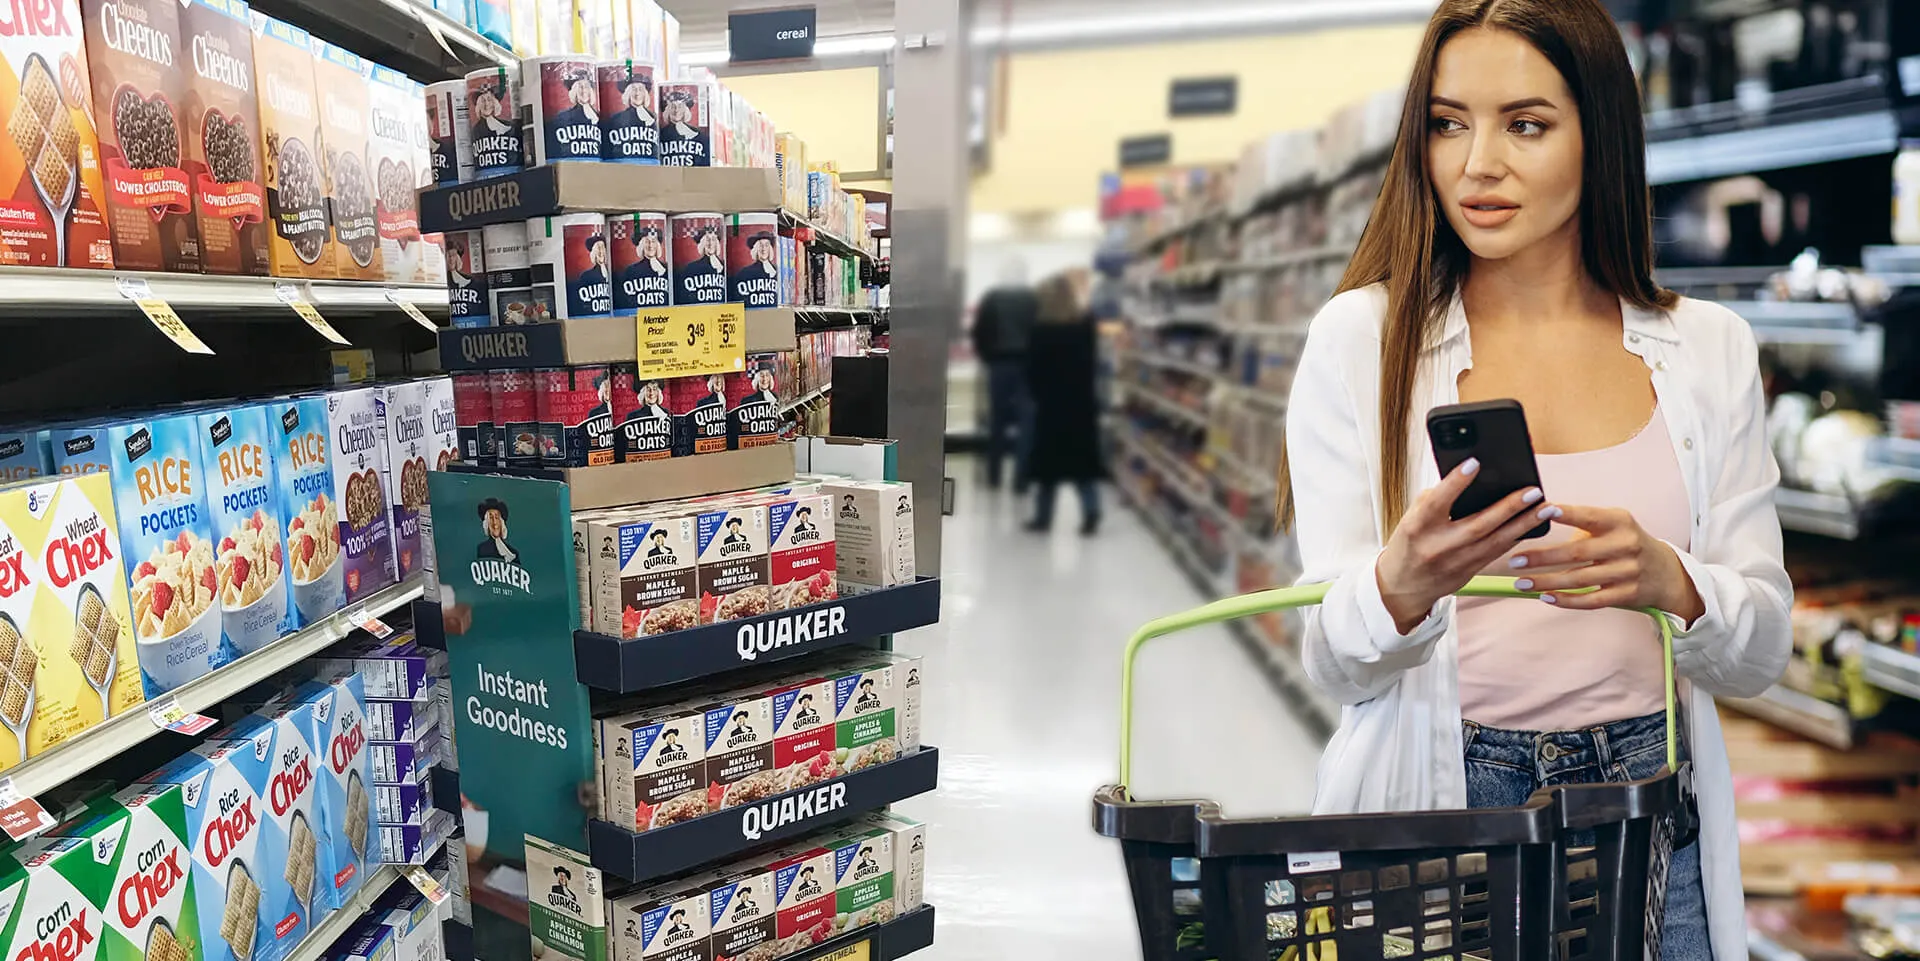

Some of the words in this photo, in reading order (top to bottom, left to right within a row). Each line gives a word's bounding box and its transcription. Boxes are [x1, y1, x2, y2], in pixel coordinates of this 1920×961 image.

[101, 3, 172, 67] Cheerios
[776, 27, 808, 40] cereal
[192, 36, 249, 92] Cheerios
[372, 107, 408, 145] Cheerios
[571, 141, 598, 155] OATS
[623, 141, 652, 156] OATS
[479, 151, 508, 167] OATS
[663, 154, 693, 167] OATS
[115, 178, 143, 194] LOWER
[144, 180, 188, 196] CHOLESTEROL
[203, 192, 227, 205] LOWER
[228, 194, 261, 208] CHOLESTEROL
[449, 181, 520, 221] QUAKER
[0, 206, 23, 220] Gluten
[23, 207, 36, 221] Free
[299, 210, 309, 222] REAL
[309, 209, 323, 220] COCOA
[288, 221, 307, 234] PEANUT
[308, 220, 325, 231] BUTTER
[697, 288, 722, 301] OATS
[737, 278, 778, 296] QUAKE
[637, 292, 665, 305] OATS
[750, 293, 775, 305] OATS
[643, 315, 669, 325] Member
[647, 326, 666, 336] Price!
[461, 332, 528, 363] QUAKER
[395, 416, 424, 443] Cheerios
[432, 408, 456, 435] Cheeri
[625, 417, 671, 441] QUAKER
[706, 421, 726, 436] OATS
[750, 419, 775, 434] OATS
[339, 425, 376, 455] Cheerios
[637, 435, 666, 450] OATS
[289, 431, 326, 471] RICE
[218, 443, 264, 487] RICE
[135, 457, 191, 506] RICE
[294, 471, 329, 496] POCKETS
[223, 485, 269, 514] POCKETS
[66, 512, 99, 541] Wheat
[141, 503, 198, 536] POCKETS
[401, 518, 417, 537] 100%
[621, 528, 633, 536] ALSO
[633, 527, 644, 535] TRY!
[790, 531, 820, 545] QUAKER
[347, 535, 366, 555] 100%
[720, 542, 752, 557] QUAKER
[46, 527, 114, 588] Chex
[644, 555, 678, 570] QUAKER
[714, 560, 735, 568] INSTANT
[791, 557, 820, 569] ORIGINAL
[0, 550, 30, 598] ex
[470, 560, 532, 594] QUAKER
[637, 573, 660, 582] INSTANT
[661, 570, 684, 578] OATMEAL
[722, 566, 744, 577] MAPLE
[745, 565, 750, 573] &
[646, 579, 670, 590] MAPLE
[671, 578, 676, 586] &
[713, 577, 737, 587] BROWN
[738, 573, 759, 584] SUGAR
[637, 590, 663, 601] BROWN
[663, 586, 685, 597] SUGAR
[244, 614, 258, 633] Rice
[258, 607, 277, 627] Cereal
[737, 606, 846, 661] QUAKER
[166, 653, 184, 669] Rice
[185, 640, 208, 661] Cereal
[477, 663, 549, 709] Instant
[854, 700, 881, 715] QUAKER
[341, 710, 354, 732] Rice
[466, 696, 568, 750] Goodness
[792, 716, 821, 731] QUAKER
[855, 721, 875, 732] APPLES
[876, 719, 881, 727] &
[727, 733, 757, 748] QUAKER
[853, 727, 882, 740] CINNAMON
[331, 719, 366, 775] Chex
[793, 739, 820, 752] ORIGINAL
[283, 745, 300, 771] Rice
[655, 751, 688, 767] QUAKER
[729, 756, 749, 766] MAPLE
[720, 766, 743, 776] BROWN
[743, 760, 764, 771] SUGAR
[271, 753, 313, 817] Chex
[649, 785, 673, 796] BROWN
[674, 779, 695, 791] SUGAR
[658, 774, 680, 786] MAPLE
[681, 773, 687, 781] &
[219, 787, 240, 817] Rice
[3, 810, 25, 822] Whole
[742, 782, 846, 840] QUAKER
[14, 816, 32, 829] Grain
[204, 795, 257, 868] Chex
[138, 838, 165, 873] Corn
[853, 866, 879, 880] QUAKER
[117, 846, 184, 929] Chex
[795, 886, 822, 902] QUAKER
[854, 886, 875, 898] APPLES
[548, 894, 582, 916] QUAKER
[853, 890, 880, 905] CINNAMON
[36, 901, 72, 941] Corn
[731, 907, 760, 923] QUAKER
[796, 909, 822, 922] ORIGINAL
[550, 920, 576, 938] APPLES
[577, 931, 582, 941] &
[663, 930, 694, 947] QUAKER
[733, 929, 754, 940] MAPLE
[548, 929, 585, 952] CINNAMON
[726, 939, 747, 951] BROWN
[748, 931, 767, 944] SUGAR
[687, 949, 694, 958] &
[824, 945, 856, 961] OATMEAL
